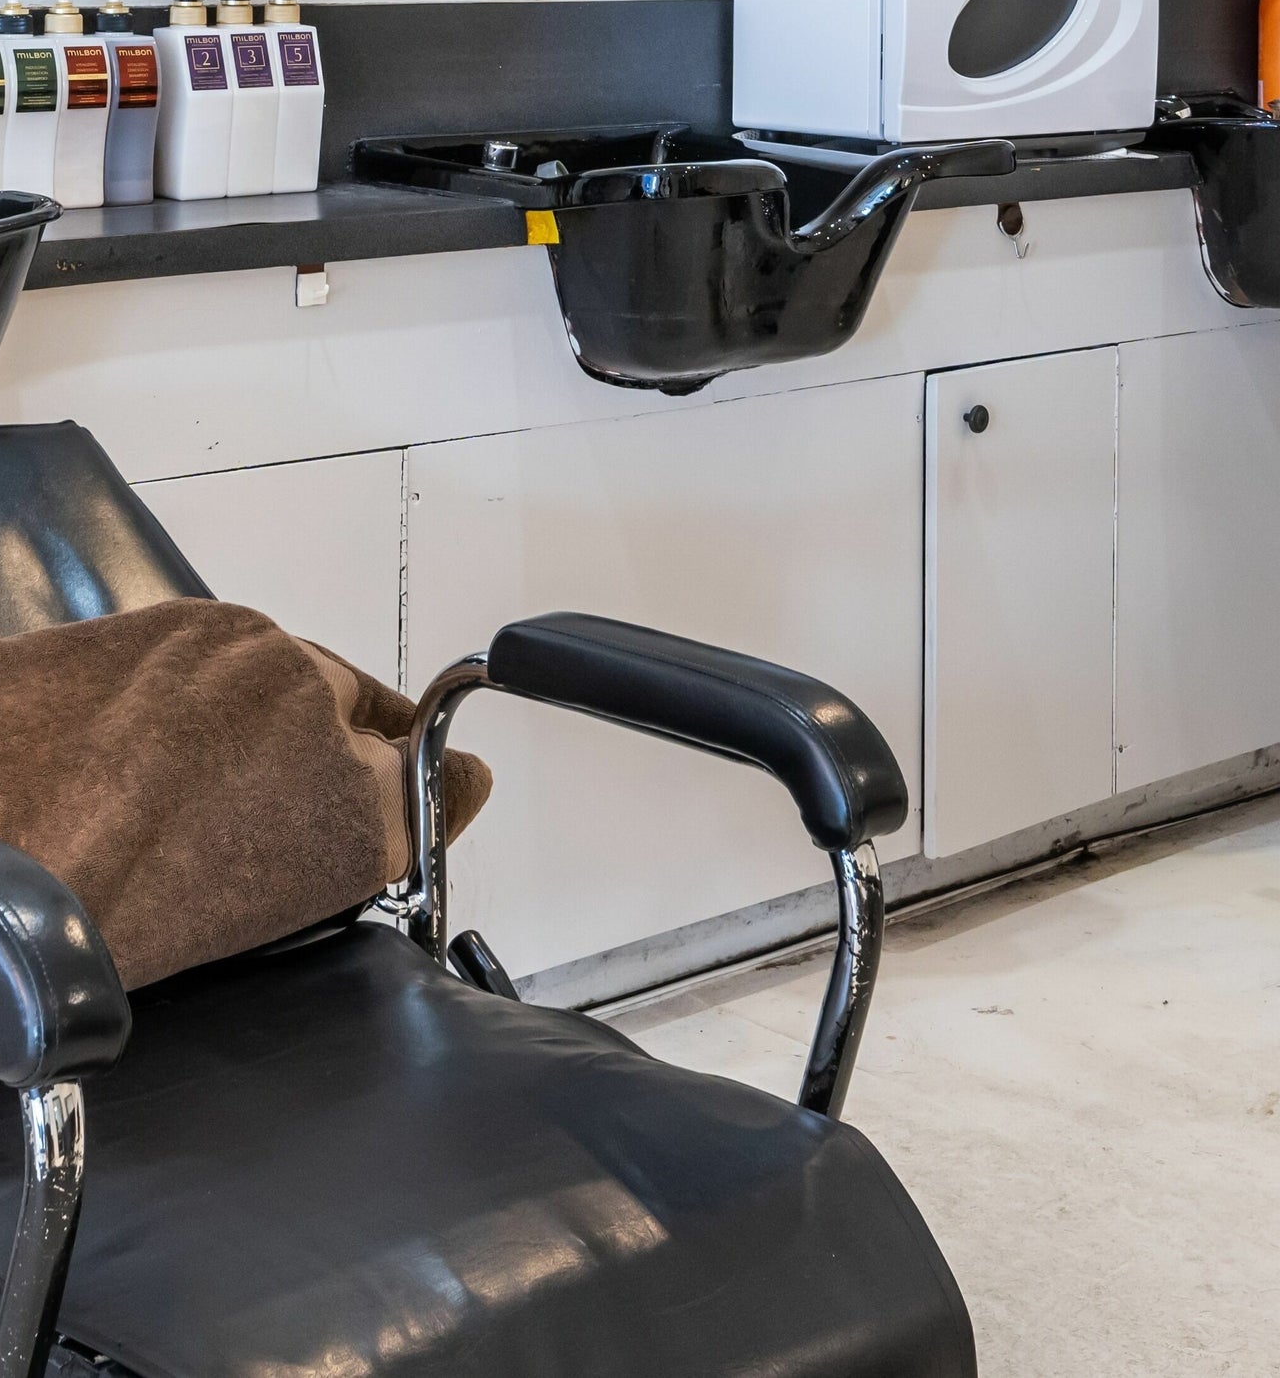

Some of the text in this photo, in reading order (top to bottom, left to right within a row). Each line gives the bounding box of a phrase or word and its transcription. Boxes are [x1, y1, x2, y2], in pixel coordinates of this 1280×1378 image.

[186, 36, 219, 44] MILBON
[232, 34, 265, 42] MILBON
[280, 32, 312, 41] MILBON
[16, 51, 52, 59] MILBON
[201, 51, 211, 66] 2
[247, 49, 256, 64] 3
[294, 47, 303, 62] 5
